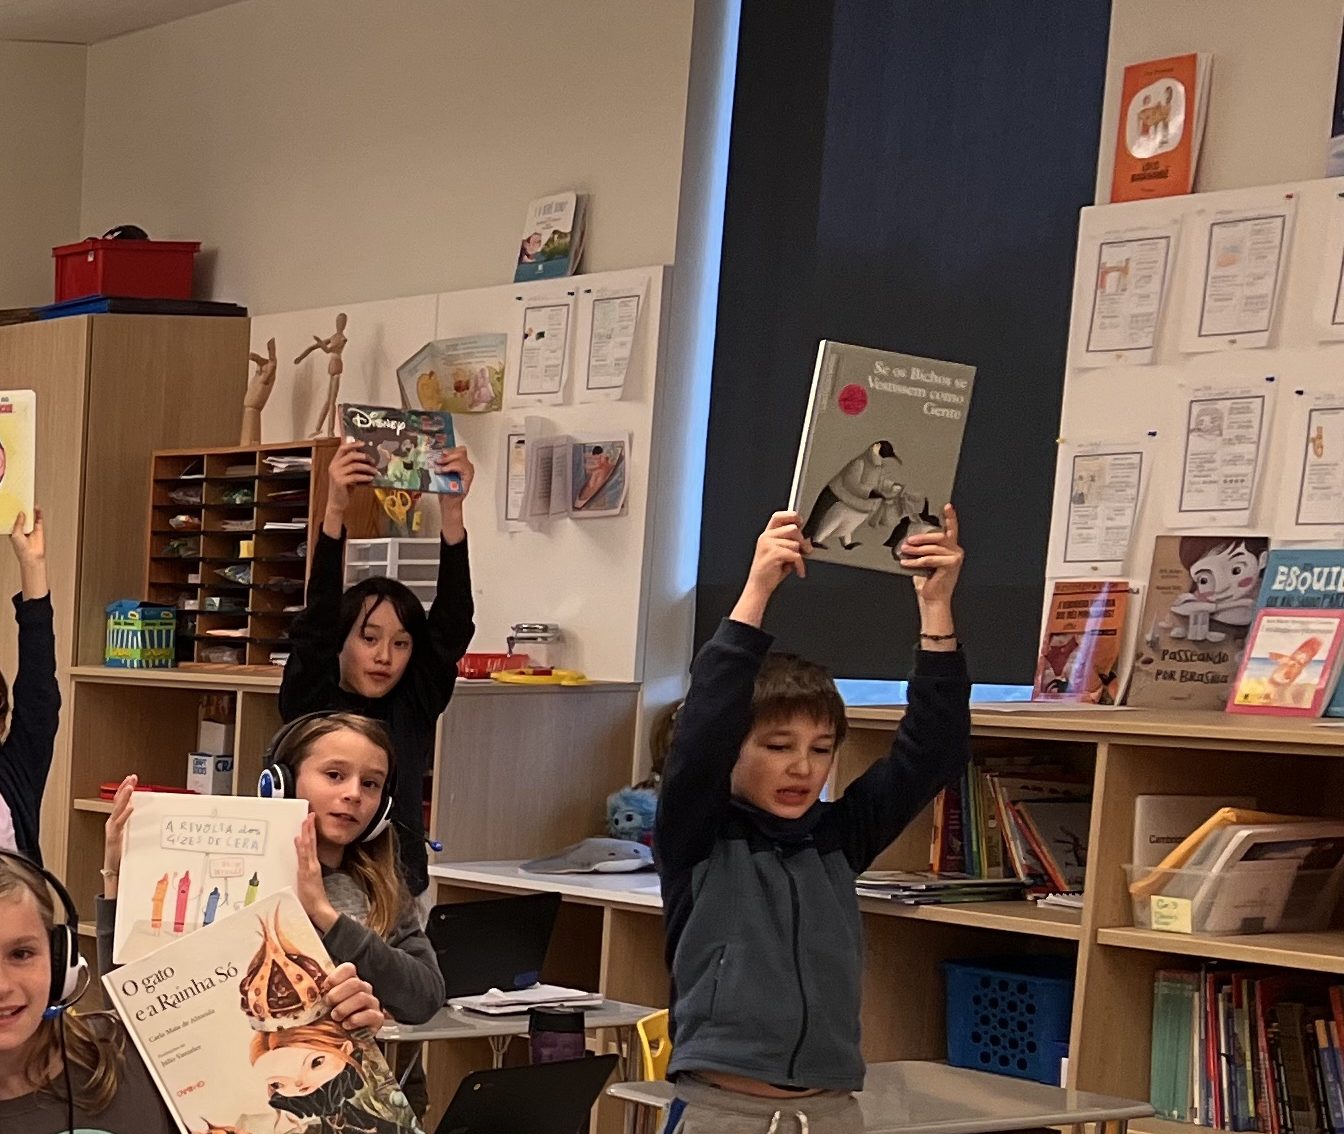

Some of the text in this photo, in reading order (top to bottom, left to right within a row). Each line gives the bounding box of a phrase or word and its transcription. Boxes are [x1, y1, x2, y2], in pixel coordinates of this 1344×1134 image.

[874, 360, 968, 389] Se os Bichos se
[929, 390, 964, 403] como
[347, 408, 406, 436] Disney
[923, 402, 962, 420] Gente
[166, 820, 173, 832] A
[238, 824, 261, 835] dos
[226, 836, 259, 850] CERA
[122, 966, 175, 997] O gato
[135, 961, 238, 1022] e a Rainha Só
